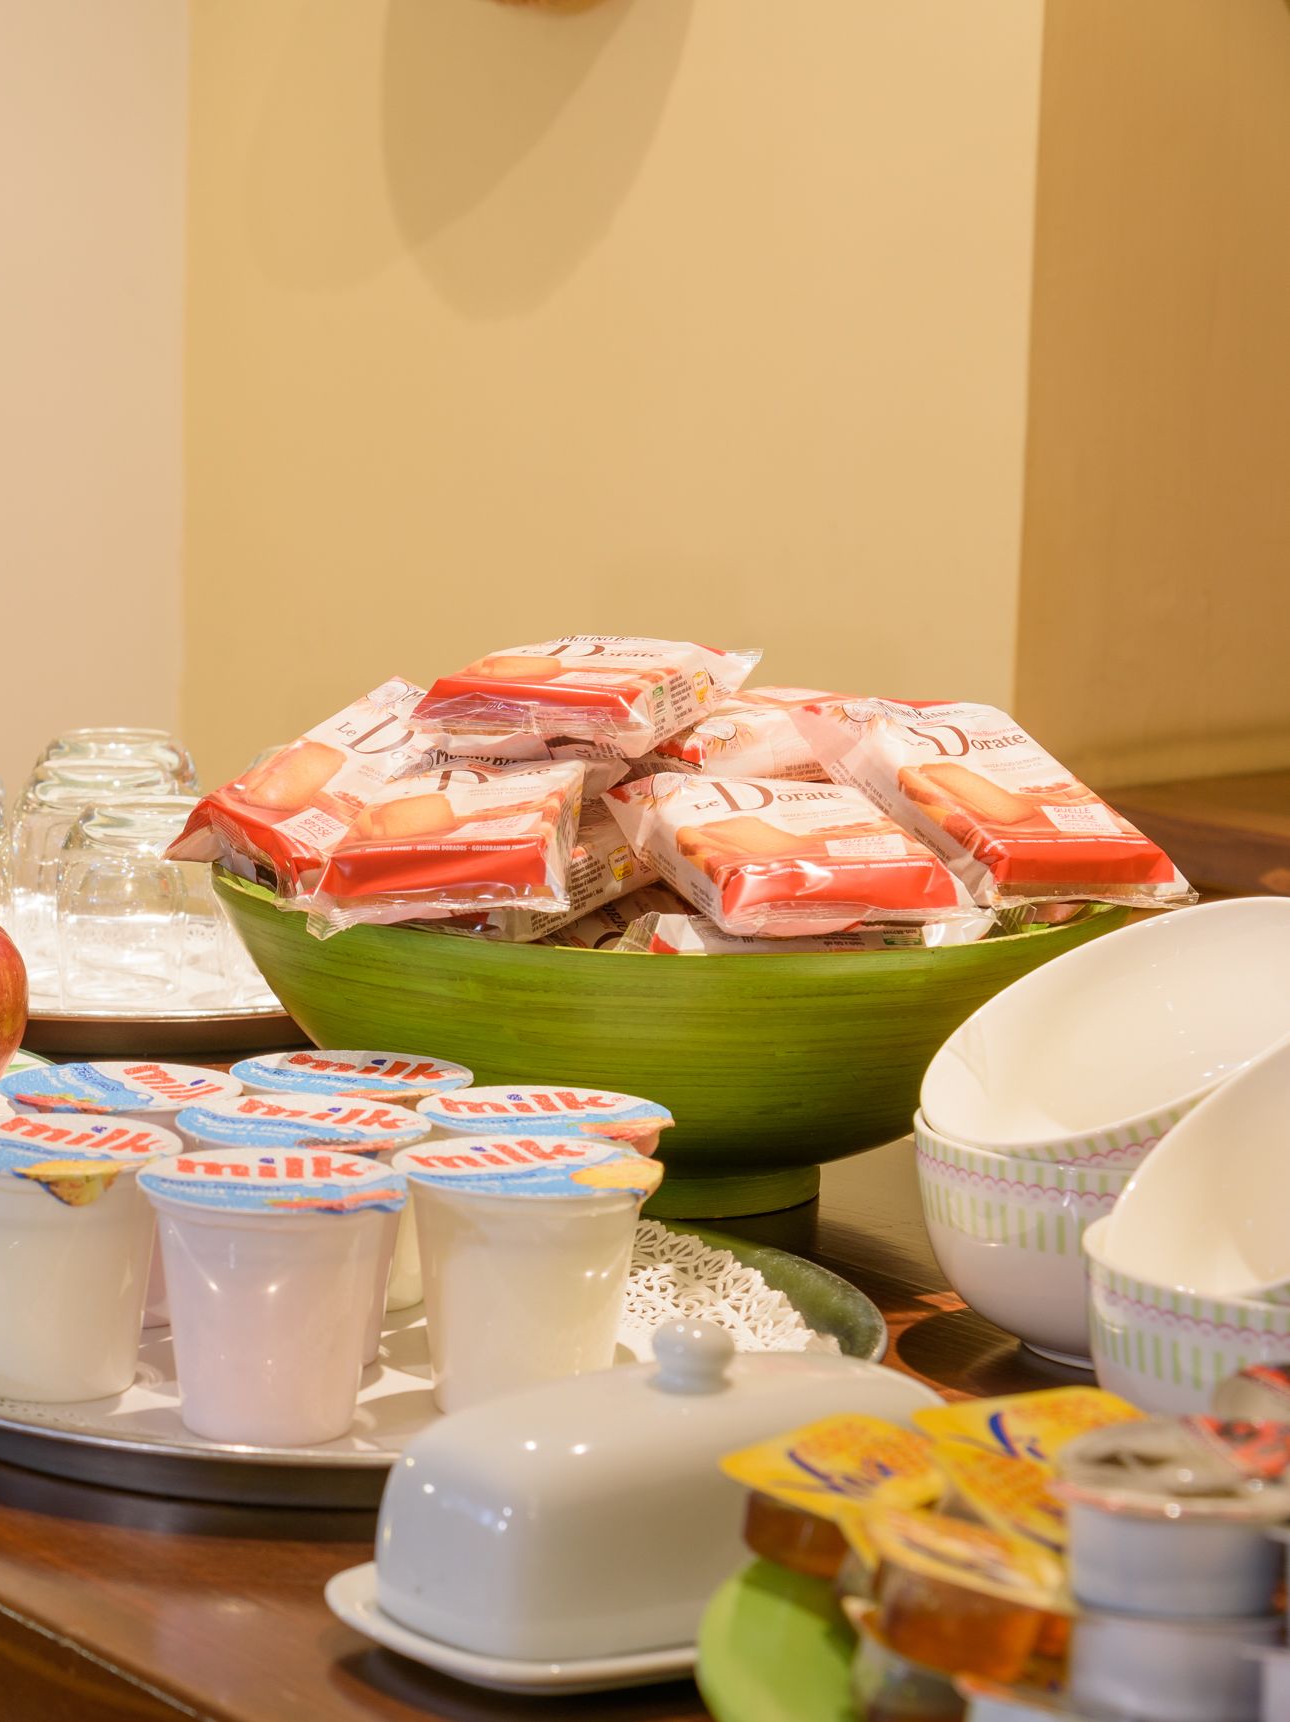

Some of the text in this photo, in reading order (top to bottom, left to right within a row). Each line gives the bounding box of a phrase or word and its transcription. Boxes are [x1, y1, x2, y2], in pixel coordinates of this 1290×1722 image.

[546, 644, 663, 657] Dorate
[335, 721, 357, 737] Le
[905, 725, 1027, 756] Dorate
[704, 782, 843, 813] Dorate
[288, 1053, 449, 1081] milk
[237, 1098, 406, 1129] milk
[438, 1092, 615, 1113] milk
[0, 1117, 162, 1152] milk
[177, 1156, 364, 1179] milk
[407, 1140, 586, 1169] milk
